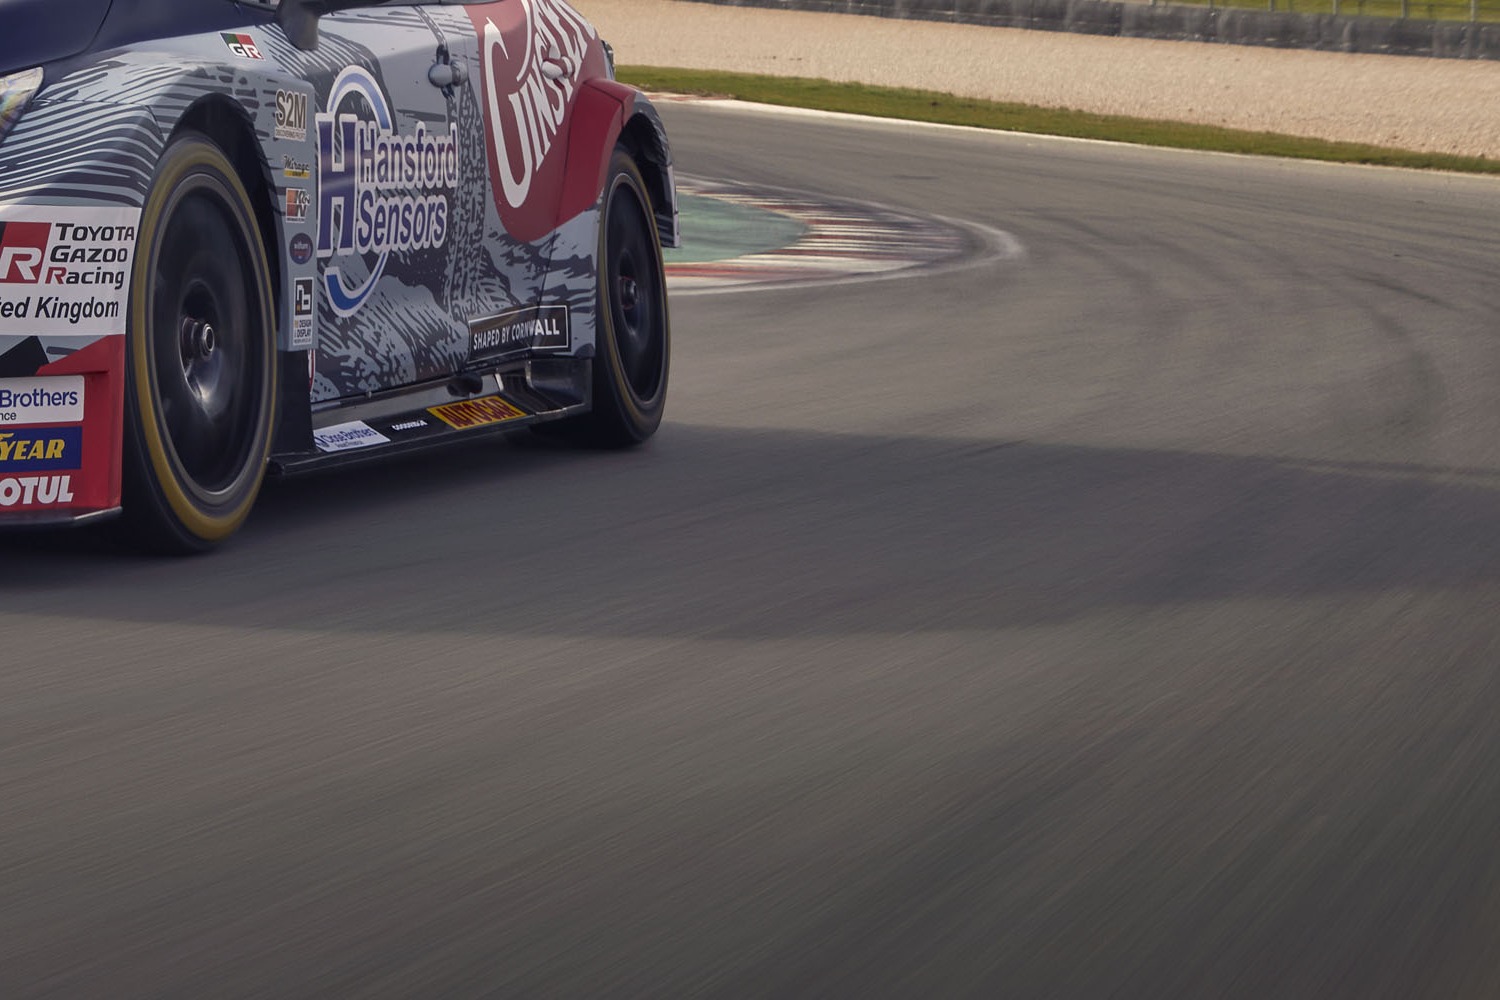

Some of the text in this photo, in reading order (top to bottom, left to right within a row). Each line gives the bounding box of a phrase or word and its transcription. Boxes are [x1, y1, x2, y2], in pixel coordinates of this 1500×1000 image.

[275, 89, 306, 130] S2M
[359, 122, 457, 186] Hansford
[55, 222, 135, 241] TOYOTA
[357, 190, 447, 250] Sensors
[49, 244, 128, 264] GAZOO
[45, 266, 125, 290] Racing
[34, 295, 119, 323] Kingdom
[473, 318, 560, 350] SHAPED BY CORNWALL
[0, 389, 78, 408] Brothers
